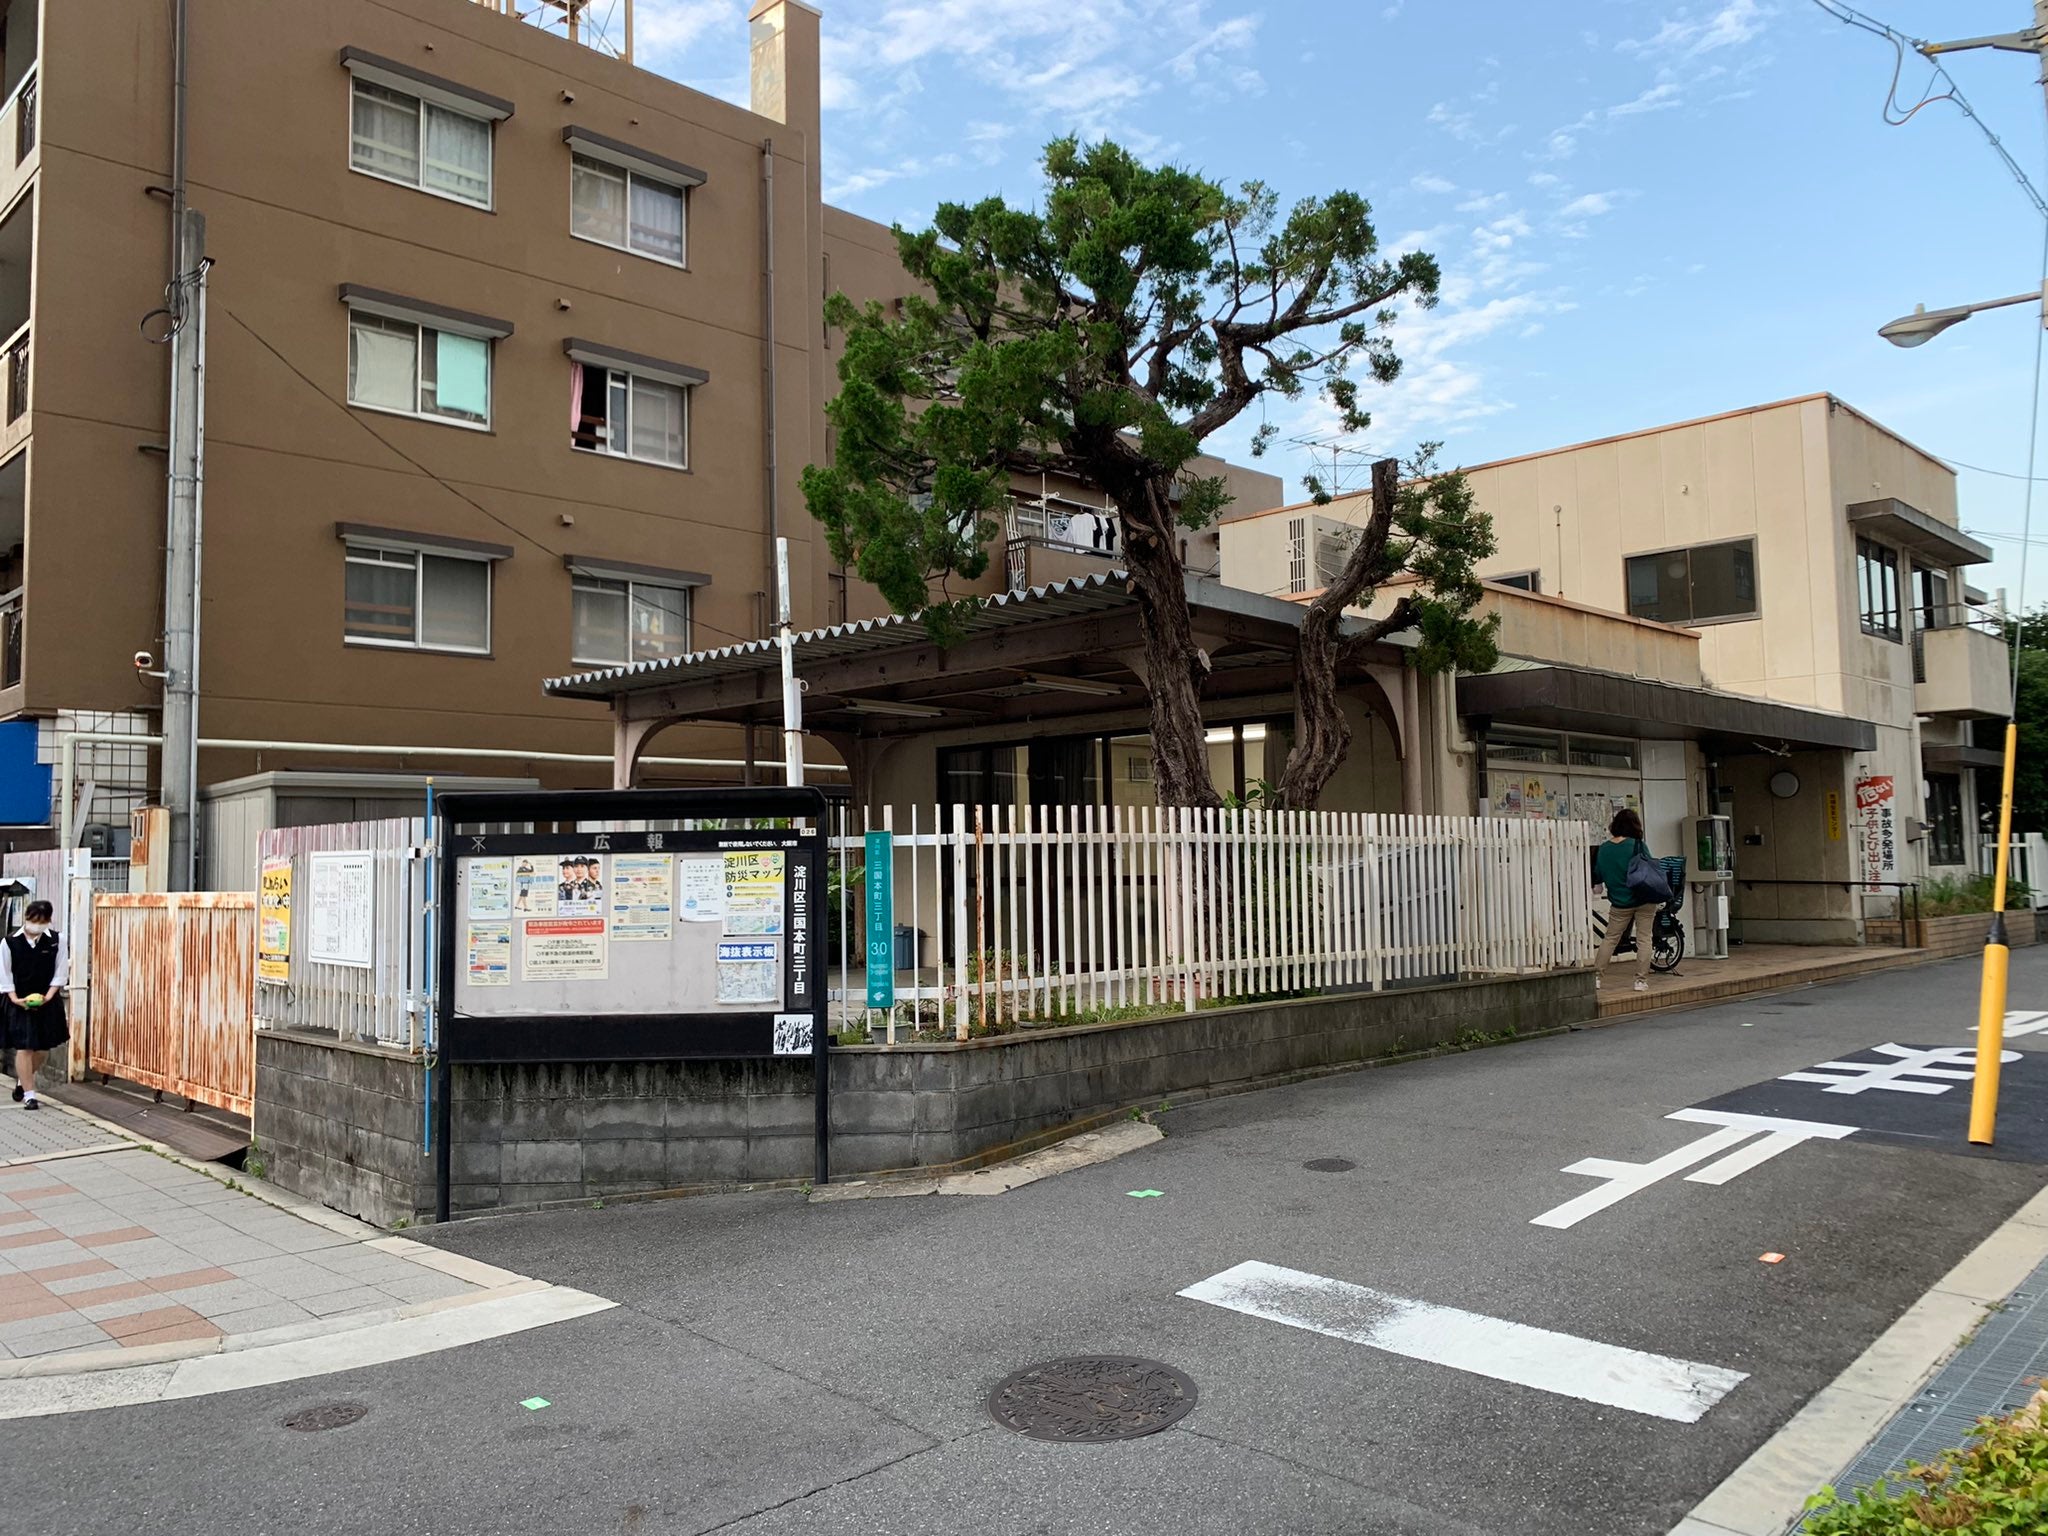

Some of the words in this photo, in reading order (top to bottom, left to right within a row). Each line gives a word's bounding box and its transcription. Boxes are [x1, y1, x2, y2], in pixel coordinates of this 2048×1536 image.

[724, 854, 760, 869] 淀川区
[725, 865, 784, 883] 防災マップ
[873, 861, 883, 932] 三国本町三丁目
[793, 865, 807, 995] 淀川区三国本町三丁目
[719, 945, 775, 958] 海抜表示板
[870, 942, 888, 956] 30
